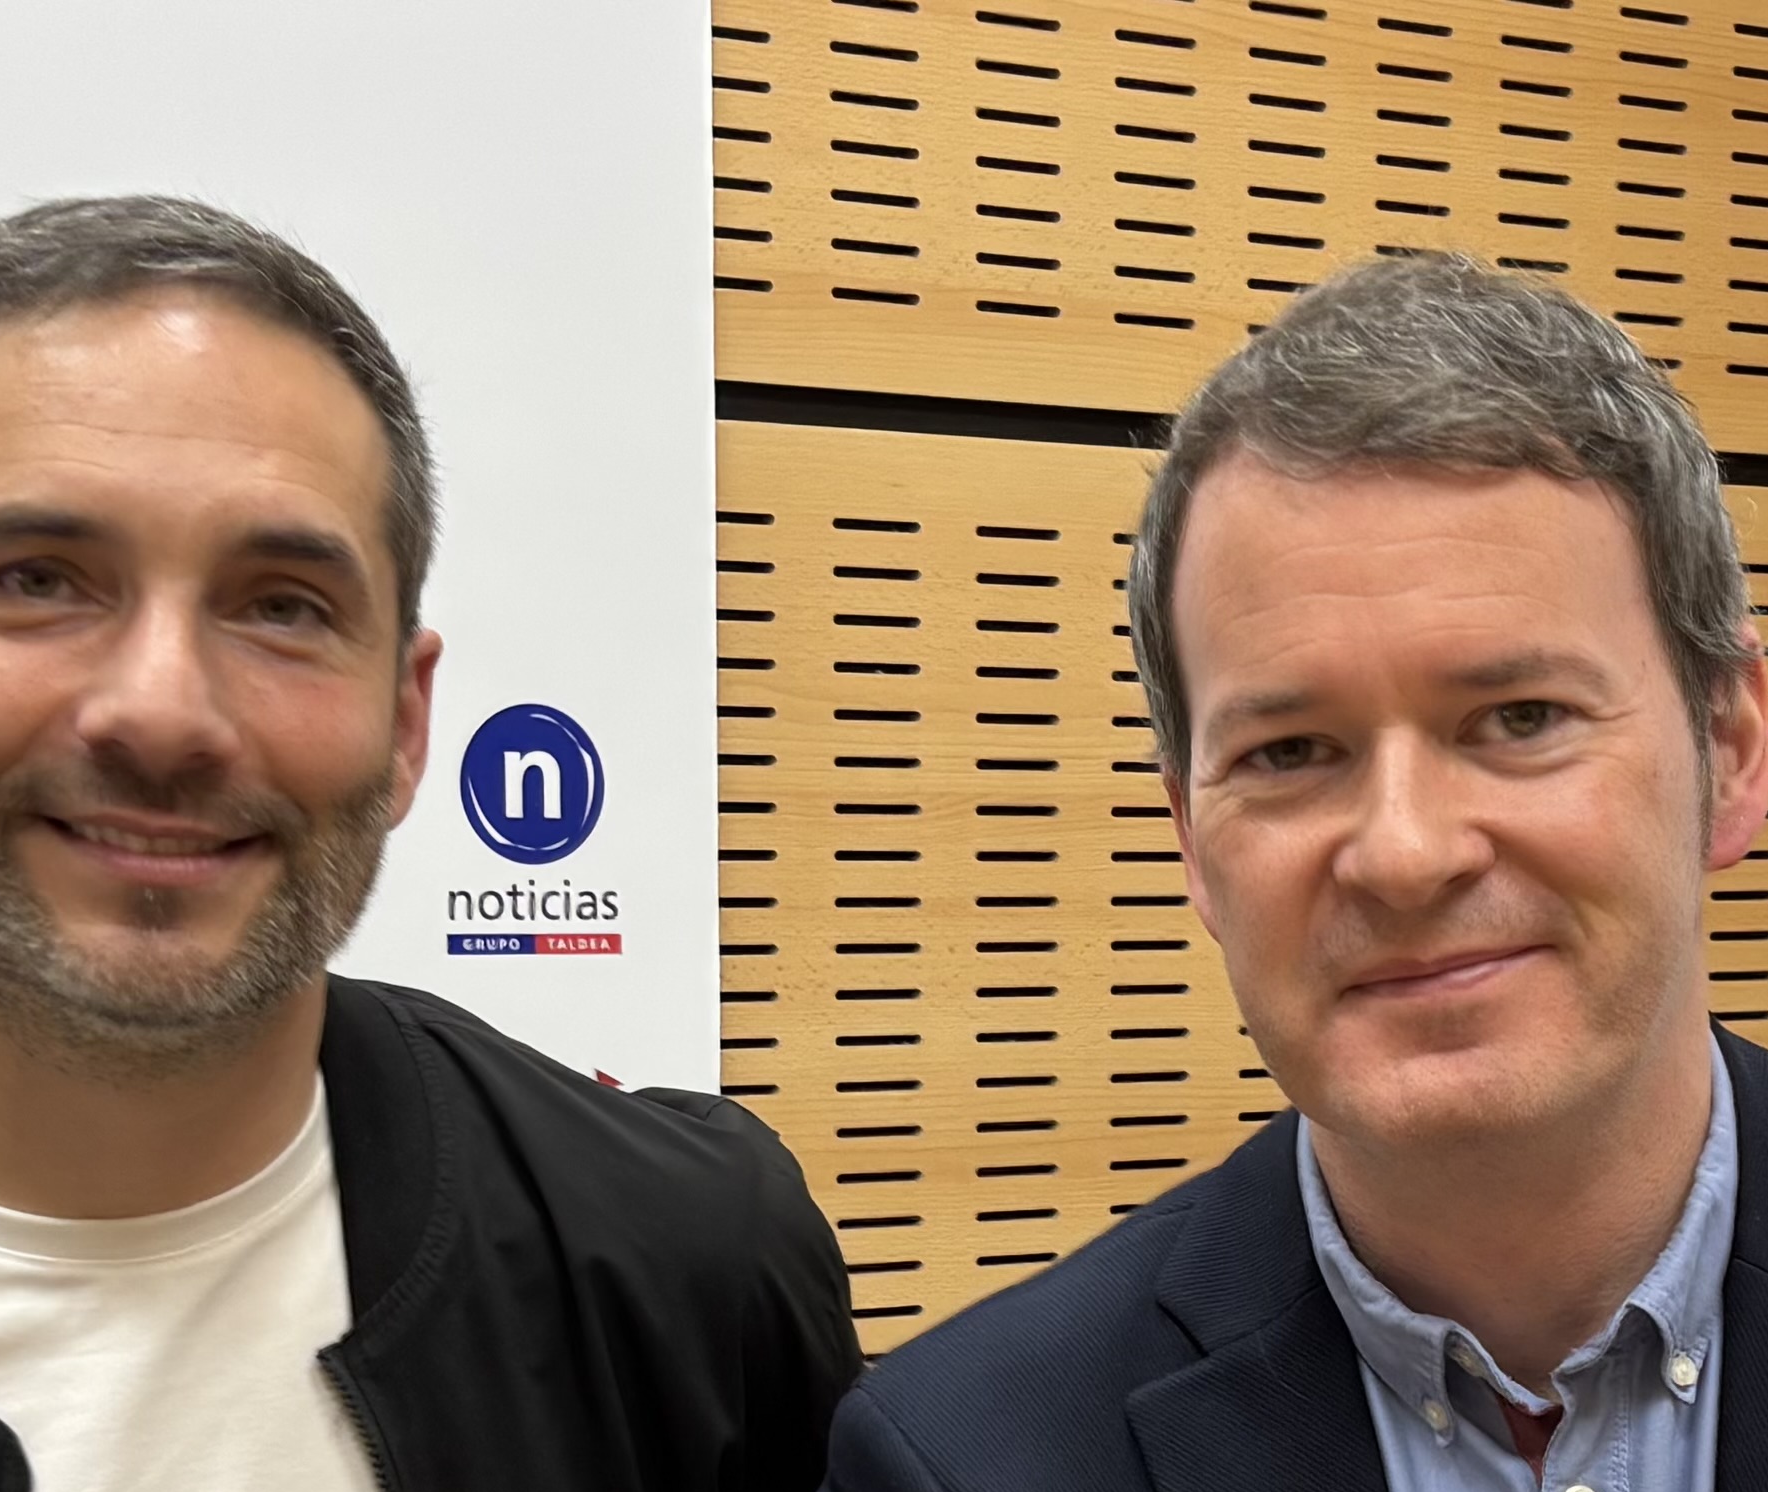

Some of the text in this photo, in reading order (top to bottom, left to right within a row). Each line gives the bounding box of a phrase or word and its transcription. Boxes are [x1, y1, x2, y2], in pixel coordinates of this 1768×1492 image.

[503, 749, 562, 819] n
[447, 879, 619, 921] noticias
[462, 938, 611, 951] GRUPO TALDEA
